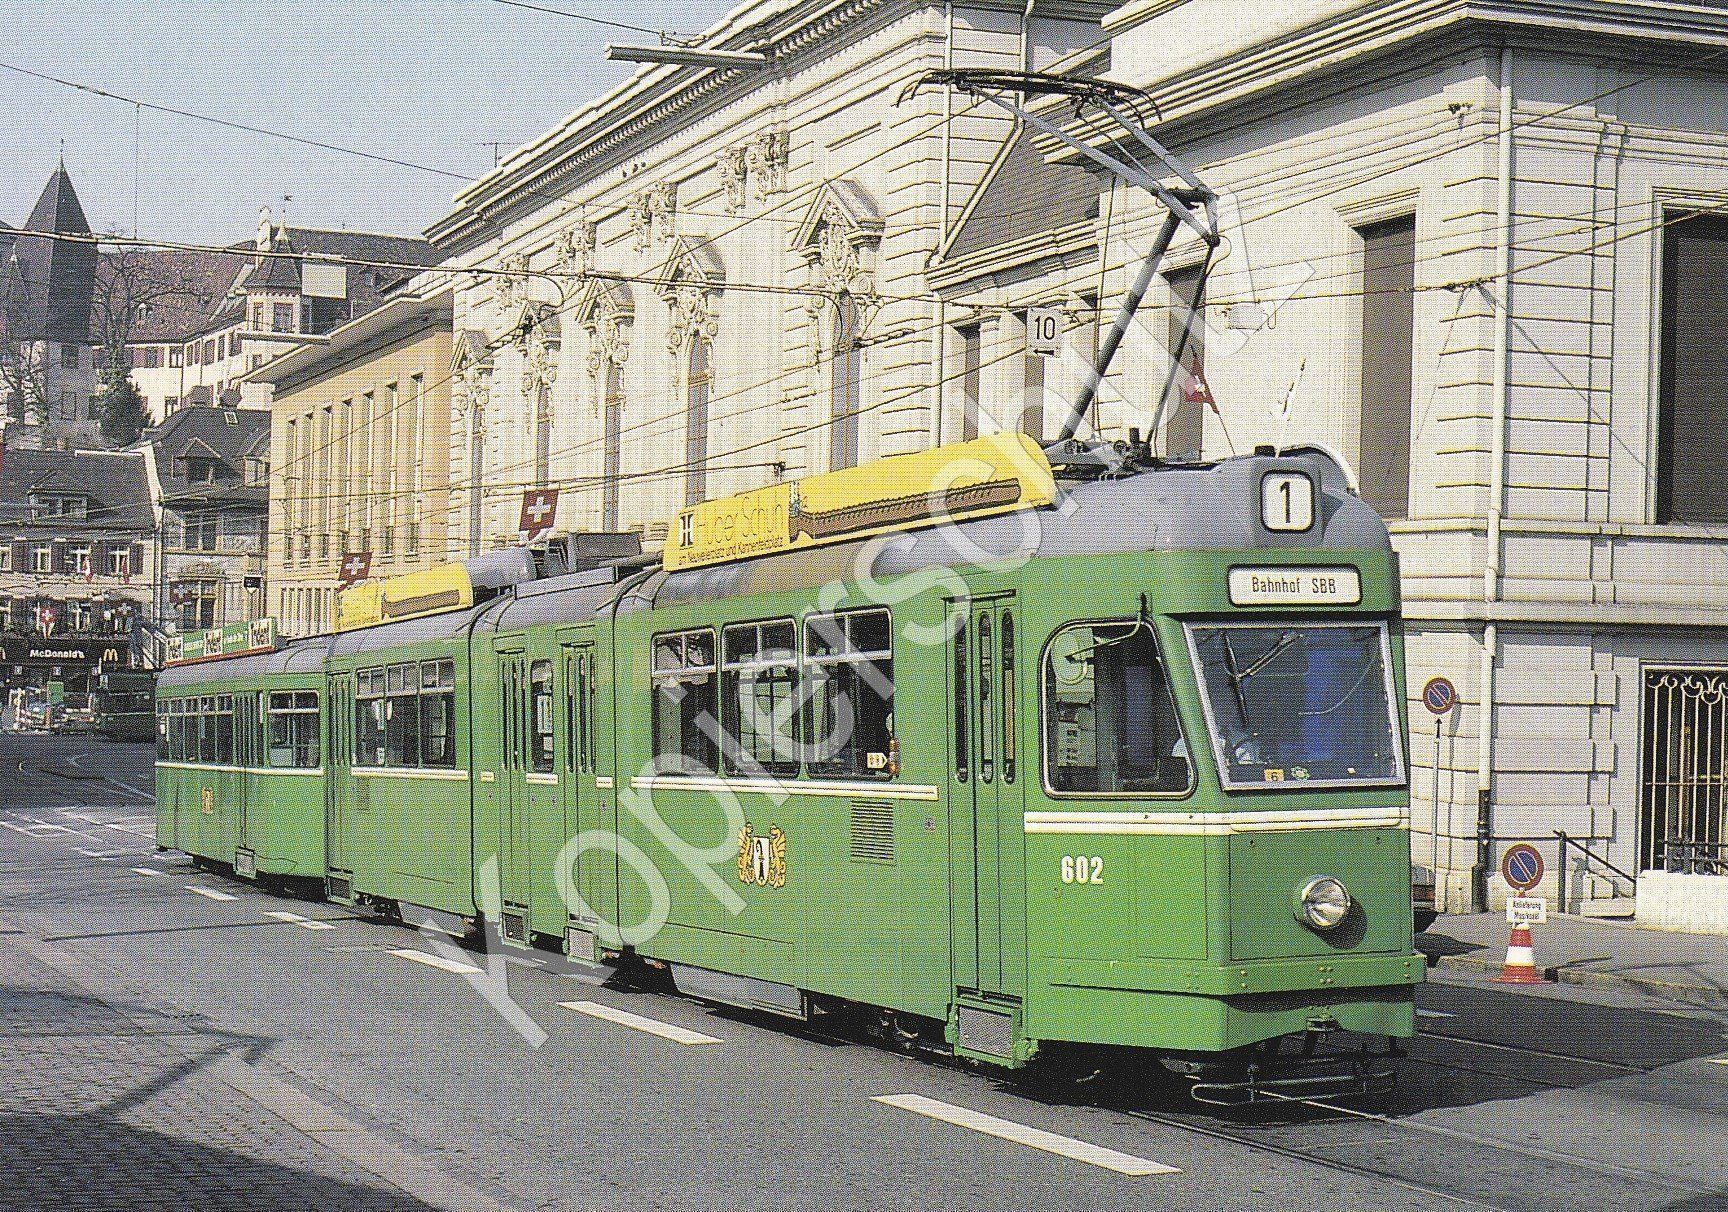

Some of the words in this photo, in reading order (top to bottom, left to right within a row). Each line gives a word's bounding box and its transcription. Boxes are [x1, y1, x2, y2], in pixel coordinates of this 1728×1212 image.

[1034, 316, 1056, 341] 10
[1279, 481, 1292, 524] 1
[1252, 576, 1301, 593] Bahnhof
[1311, 578, 1336, 594] SBB
[29, 649, 85, 659] McDonald's
[1060, 855, 1104, 885] 602
